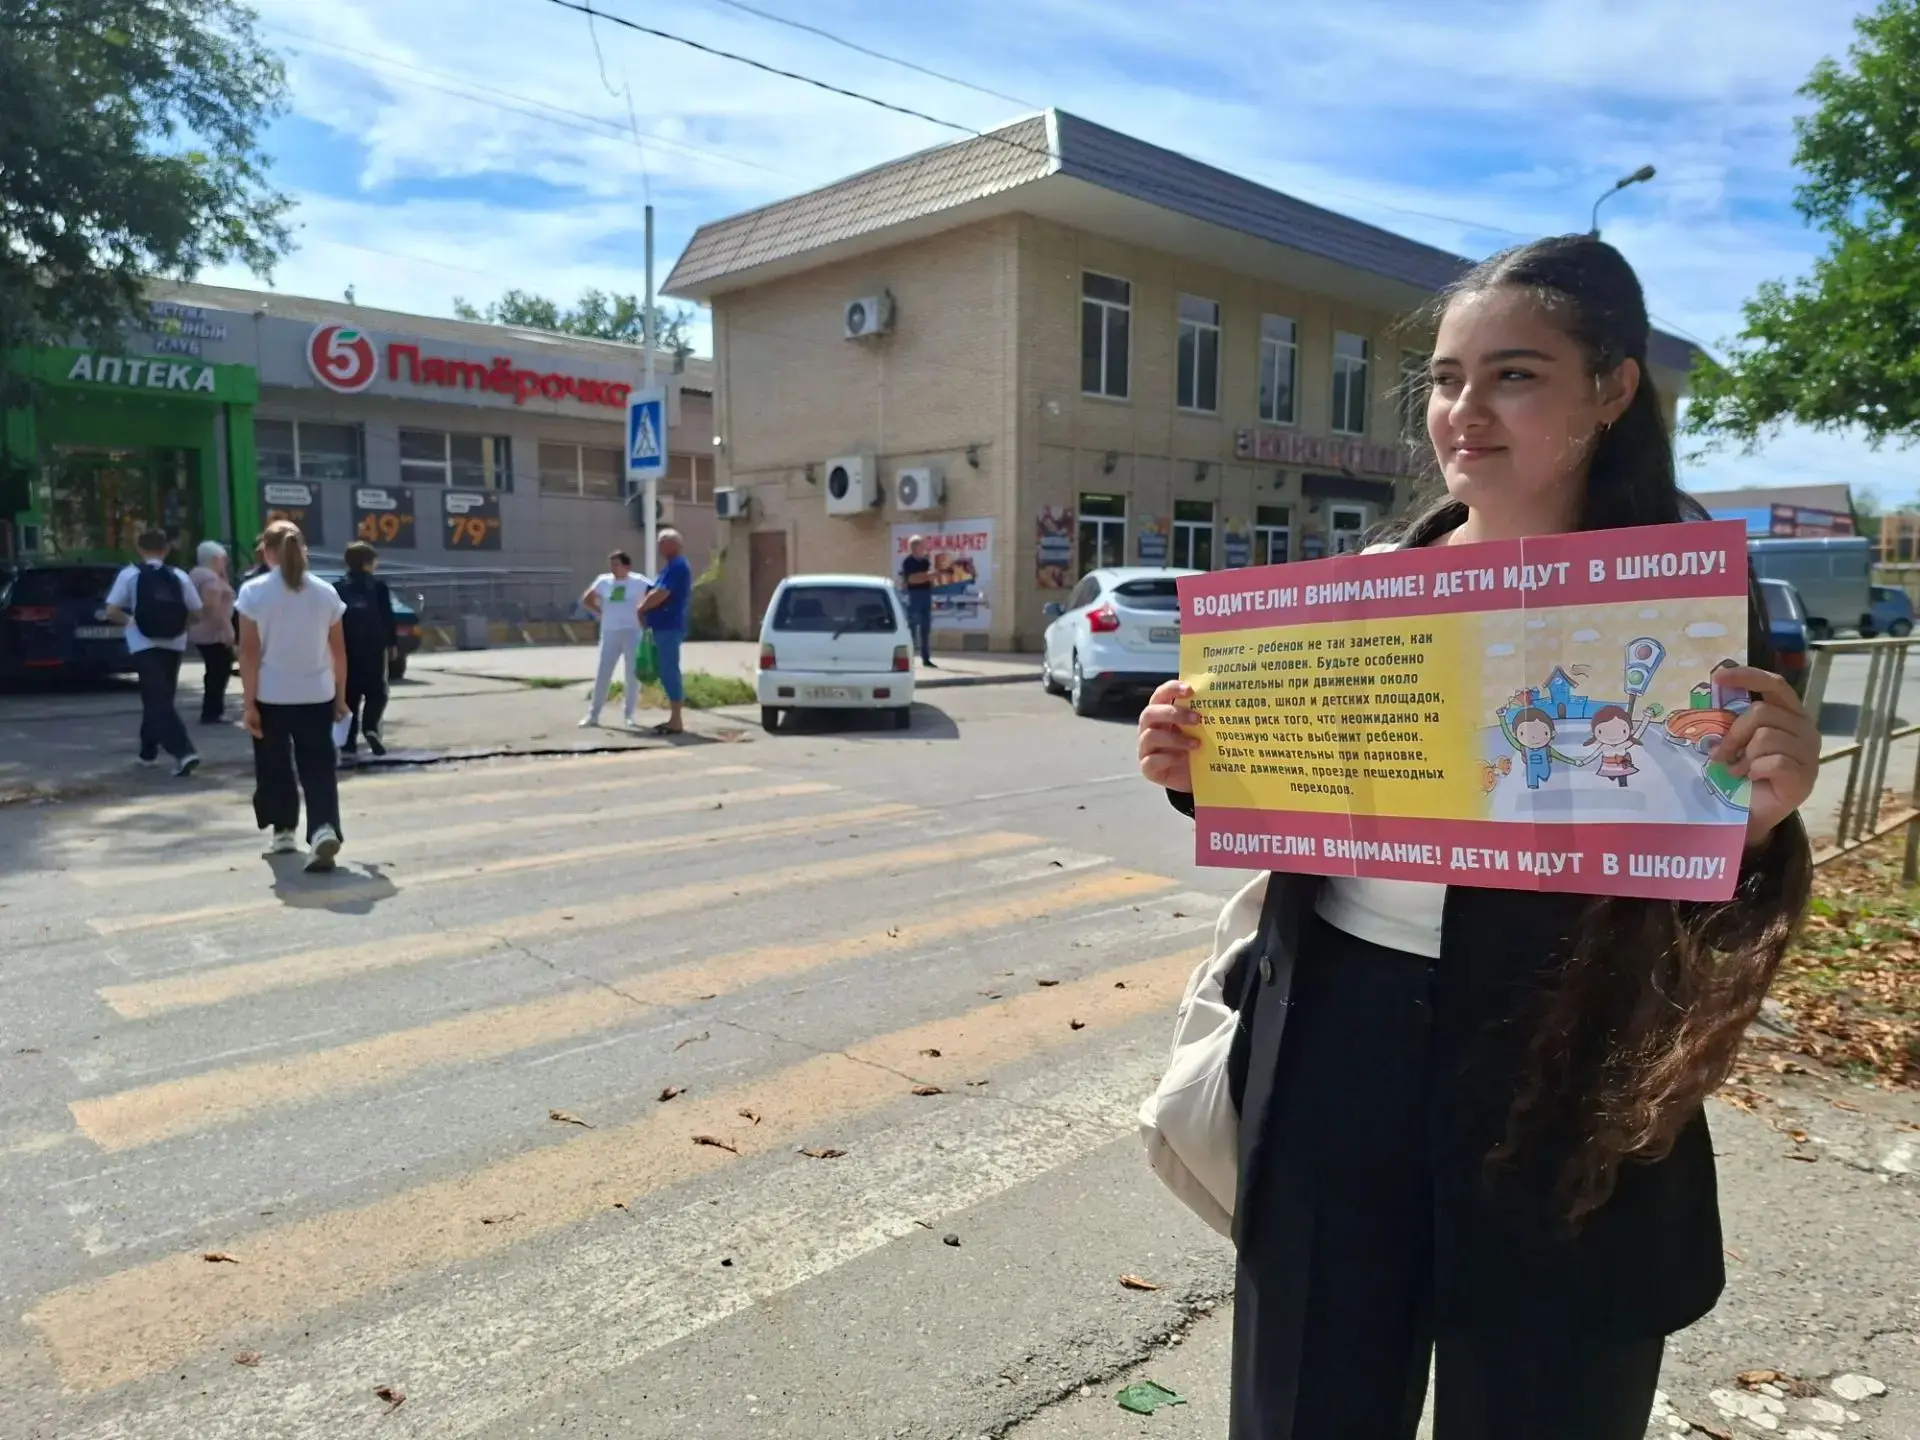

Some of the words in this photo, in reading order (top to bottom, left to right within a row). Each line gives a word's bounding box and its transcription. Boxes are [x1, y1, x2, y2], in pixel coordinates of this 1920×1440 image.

[68, 353, 216, 393] АПТЕКА
[386, 341, 632, 408] Пятёрочка
[449, 517, 486, 546] 79
[1193, 588, 1297, 617] ВОДИТЕЛИ!
[1305, 575, 1425, 606] ВНИМАНИЕ!
[1433, 568, 1494, 598] ДЕТИ
[1503, 562, 1570, 591] ИДУТ
[1589, 559, 1607, 582] В
[1616, 550, 1726, 581] ШКОЛУ!
[1203, 643, 1245, 659] Помните
[1257, 640, 1304, 656] ребенок
[1308, 639, 1322, 651] не
[1326, 638, 1345, 650] так
[1350, 635, 1405, 648] заметен,
[1410, 632, 1433, 644] как
[1207, 660, 1257, 676] взрослый
[1261, 658, 1312, 671] человек.
[1317, 656, 1360, 670] Будьте
[1364, 653, 1424, 667] особенно
[1209, 678, 1284, 691] внимательны
[1288, 677, 1309, 690] при
[1313, 674, 1375, 688] движении
[1380, 673, 1418, 685] около
[1190, 698, 1231, 710] детских
[1235, 697, 1271, 710] садов,
[1275, 695, 1306, 708] школ
[1310, 696, 1317, 705] и
[1322, 694, 1370, 708] детских
[1375, 691, 1445, 706] площадок,
[1219, 714, 1250, 726] велик
[1255, 714, 1280, 727] риск
[1284, 714, 1313, 727] того,
[1317, 714, 1336, 725] что
[1341, 712, 1419, 726] неожиданно
[1424, 712, 1440, 723] на
[1216, 731, 1269, 744] проезжую
[1272, 732, 1304, 743] часть
[1308, 731, 1361, 743] выбежит
[1366, 730, 1424, 744] ребенок.
[1218, 745, 1255, 758] Будьте
[1259, 748, 1335, 760] внимательны
[1338, 750, 1359, 762] при
[1363, 750, 1428, 763] парковке,
[1209, 762, 1246, 774] начале
[1250, 764, 1309, 777] движения,
[1312, 766, 1359, 779] проезде
[1363, 767, 1445, 780] пешеходных
[1290, 782, 1355, 796] переходов.
[1209, 831, 1317, 856] ВОДИТЕЛИ!
[1323, 838, 1442, 866] ВНИМАНИЕ!
[1450, 847, 1509, 871] ДЕТИ
[1517, 850, 1584, 877] ИДУТ
[1602, 853, 1620, 876] В
[1628, 853, 1727, 880] ШКОЛУ!
